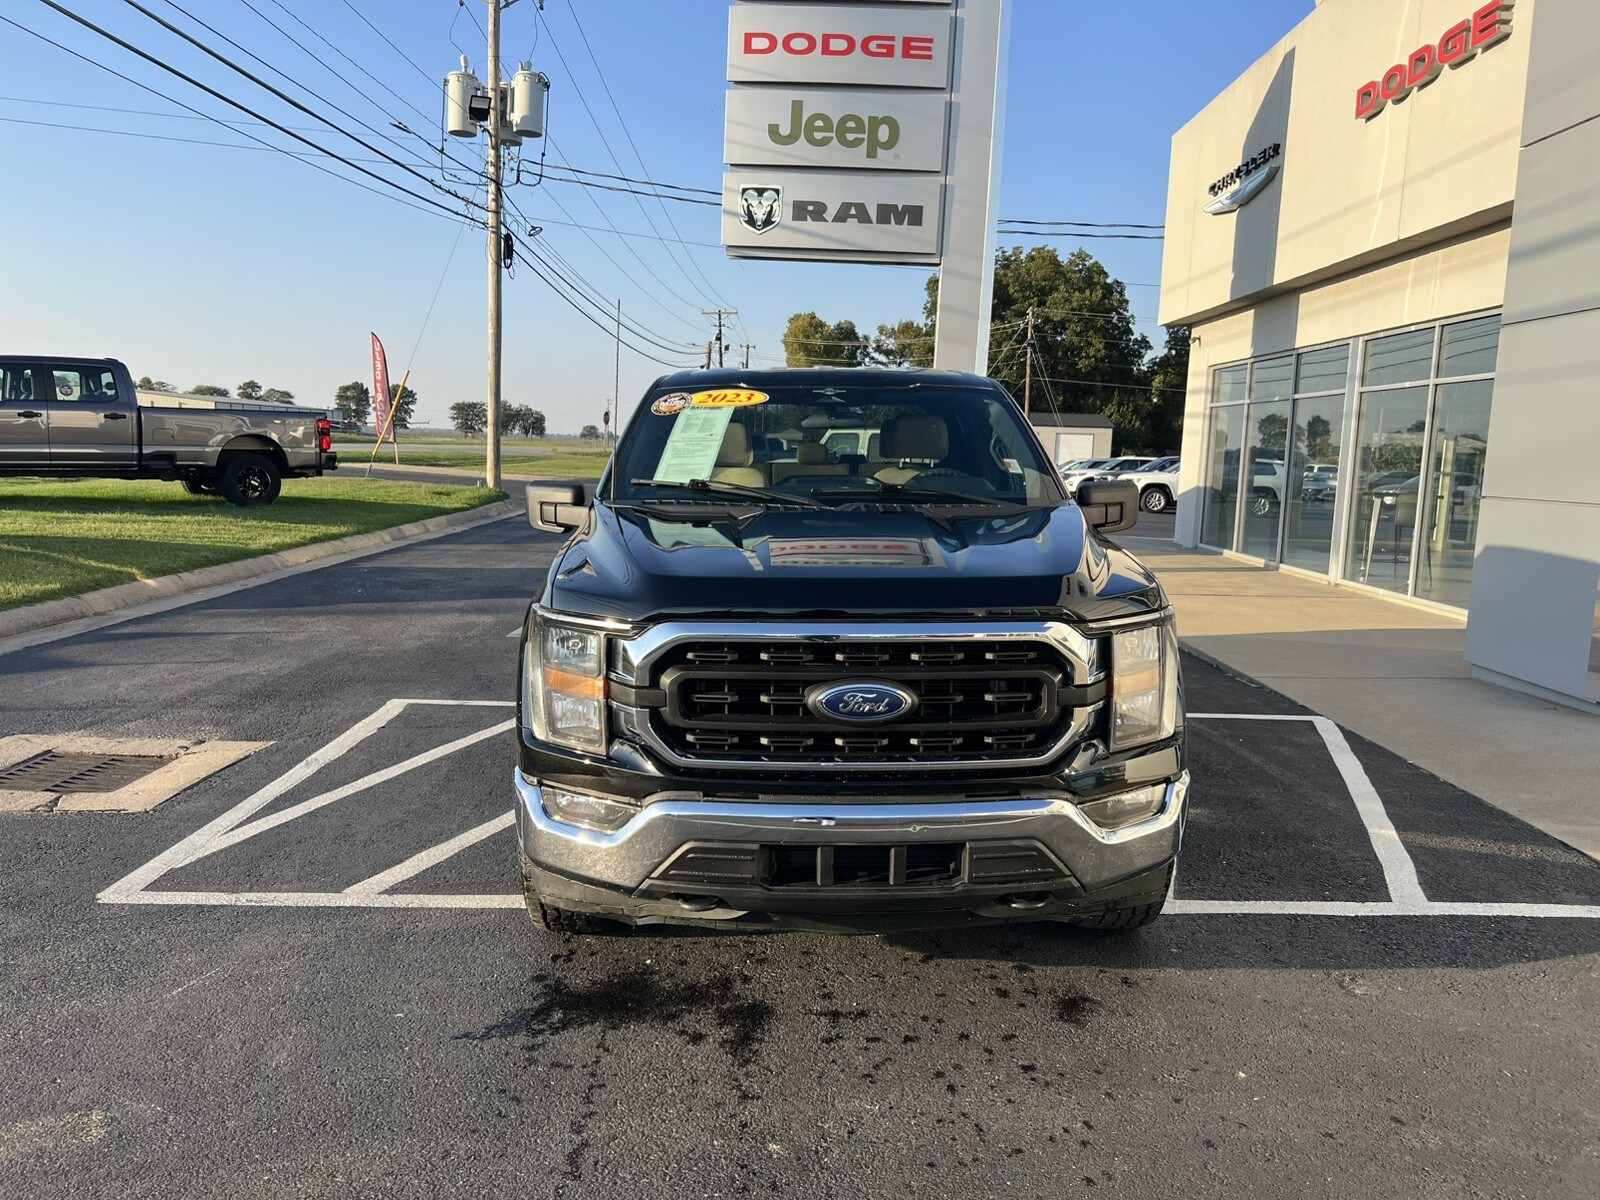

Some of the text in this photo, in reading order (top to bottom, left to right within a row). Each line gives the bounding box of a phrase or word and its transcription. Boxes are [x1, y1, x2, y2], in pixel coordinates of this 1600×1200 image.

[743, 32, 934, 60] DODGE
[1355, 0, 1504, 120] DODGE
[768, 99, 901, 159] Jeep
[791, 200, 923, 227] RAM
[698, 392, 755, 404] 2023
[838, 692, 889, 713] Ford
